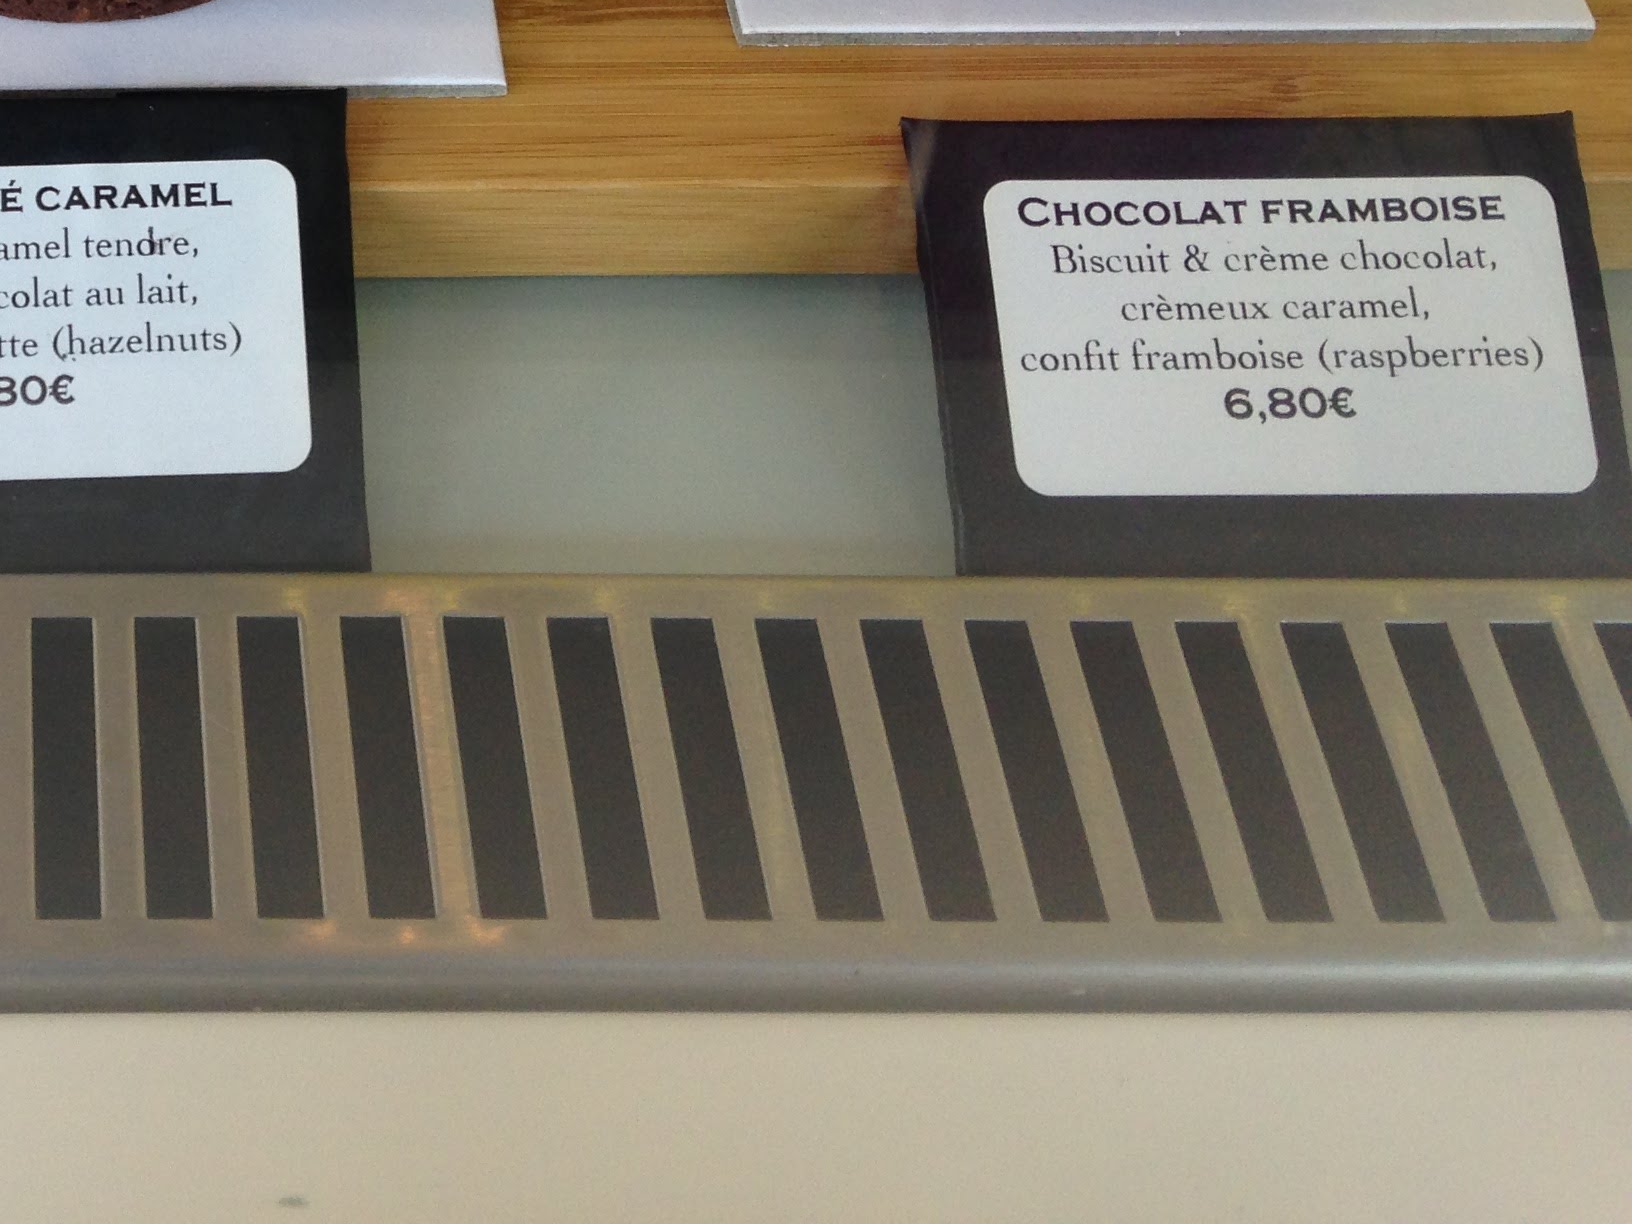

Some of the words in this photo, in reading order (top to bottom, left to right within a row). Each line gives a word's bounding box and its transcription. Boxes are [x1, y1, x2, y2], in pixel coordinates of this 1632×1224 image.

[35, 181, 233, 211] CARAMEL
[1260, 195, 1505, 224] FRAMBOISE
[84, 226, 198, 258] tendre,
[1050, 243, 1169, 273] Biscuit
[1184, 244, 1210, 272] &
[1224, 245, 1329, 272] crème
[1340, 238, 1496, 271] chocolat,
[86, 288, 124, 306] au
[137, 273, 197, 306] lait,
[1121, 294, 1271, 321] crèmeux
[1283, 285, 1429, 320] caramel,
[52, 321, 241, 362] (hazelnuts)
[1021, 339, 1119, 371] confit
[1132, 337, 1304, 370] framboise
[1319, 335, 1543, 377] (raspberries)
[1224, 387, 1357, 424] 6,80€
